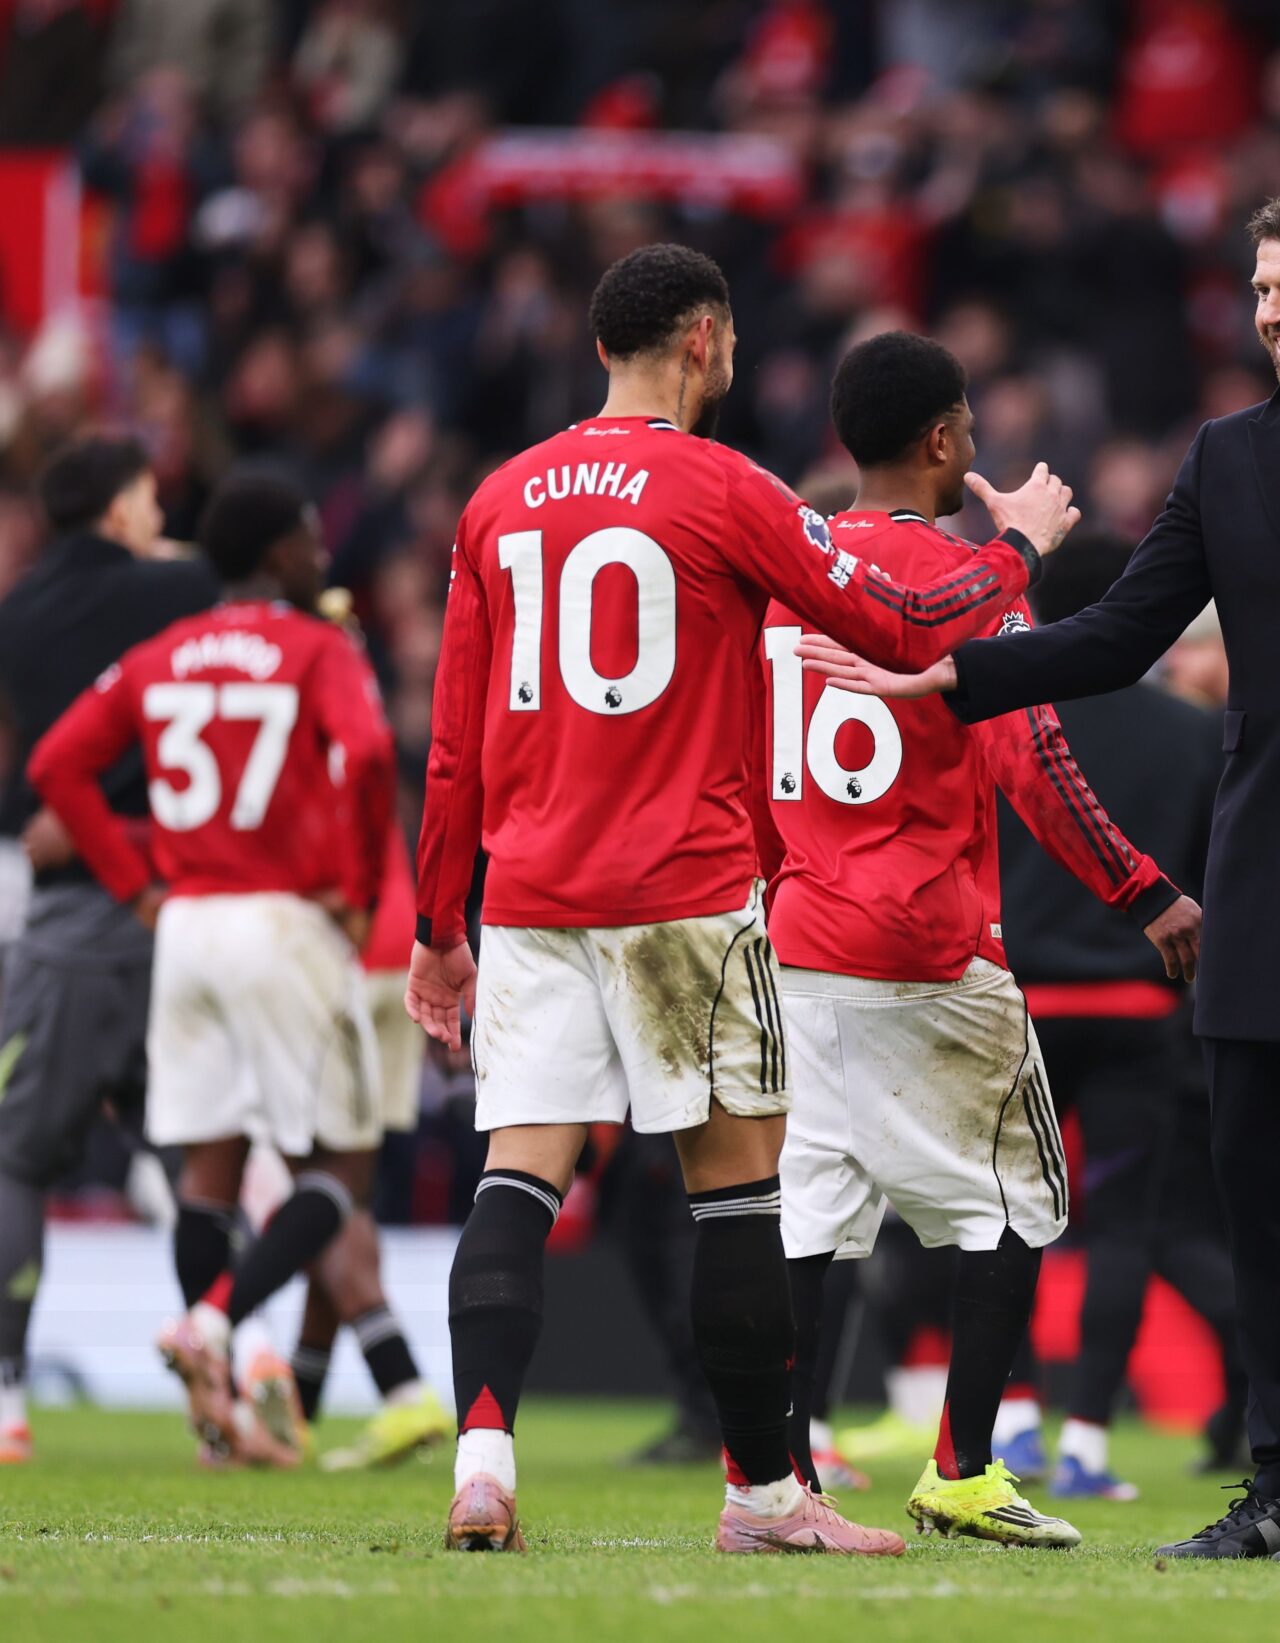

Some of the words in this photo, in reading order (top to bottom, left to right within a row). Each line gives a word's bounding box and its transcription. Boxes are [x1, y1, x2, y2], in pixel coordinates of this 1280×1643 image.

[523, 461, 649, 509] CUNHA
[498, 526, 676, 715] 10
[142, 681, 300, 831] 37
[763, 626, 903, 805] 16
